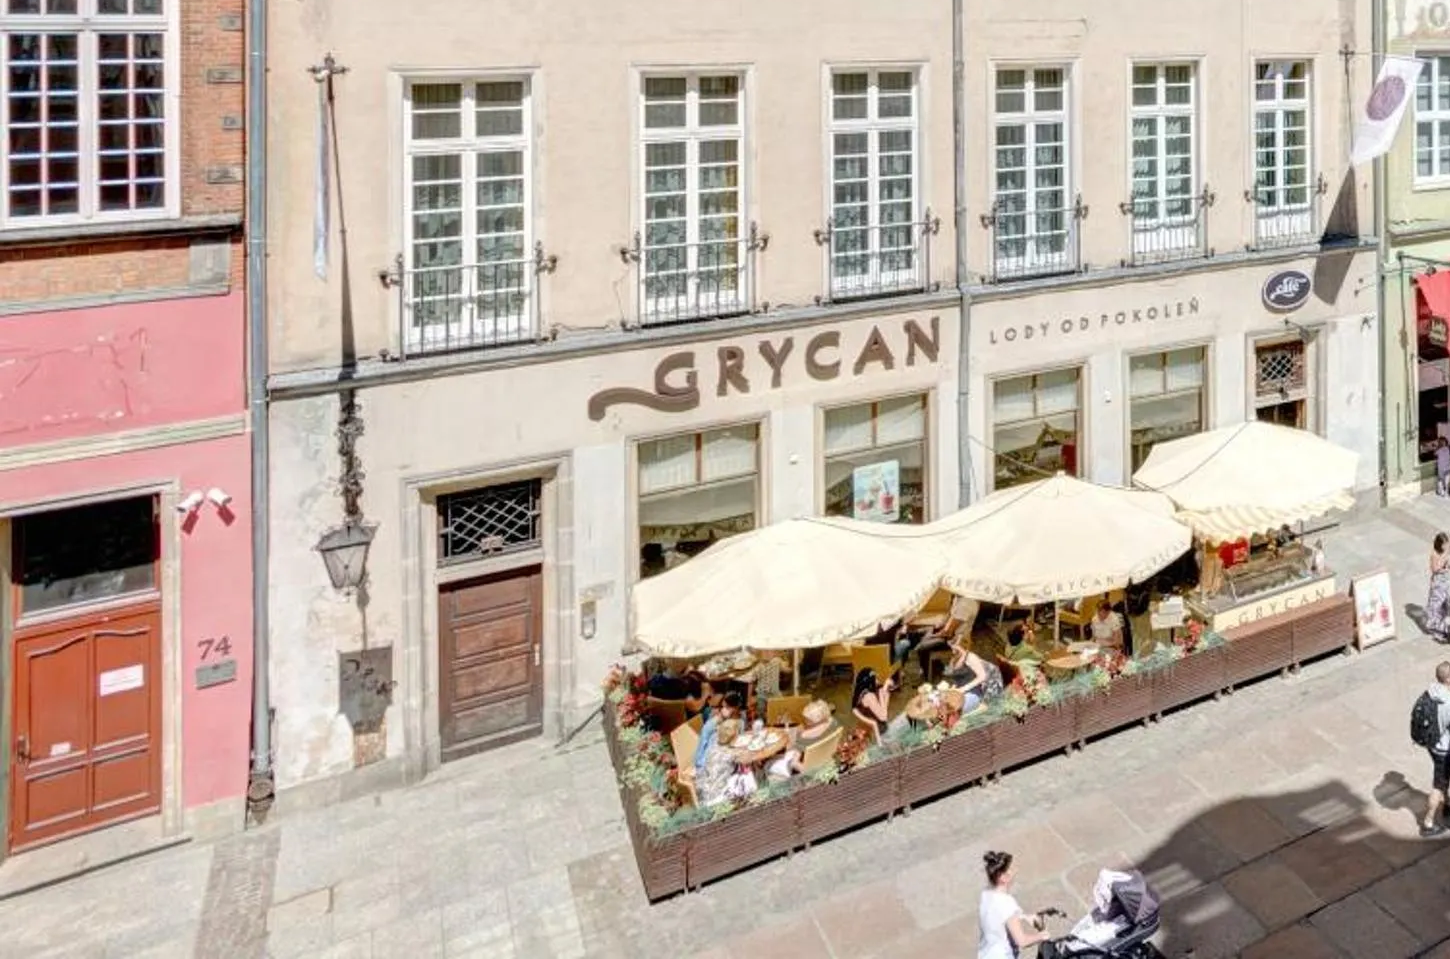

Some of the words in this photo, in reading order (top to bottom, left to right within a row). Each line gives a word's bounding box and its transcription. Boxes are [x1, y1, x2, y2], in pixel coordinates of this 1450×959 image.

[989, 322, 1050, 344] LODY
[1060, 317, 1090, 334] OD
[1100, 297, 1200, 327] POKOLEŃ
[588, 316, 941, 420] GRYCAN
[1043, 576, 1115, 596] GRYCAN
[1237, 588, 1326, 625] GRYCAN
[198, 636, 232, 661] 74
